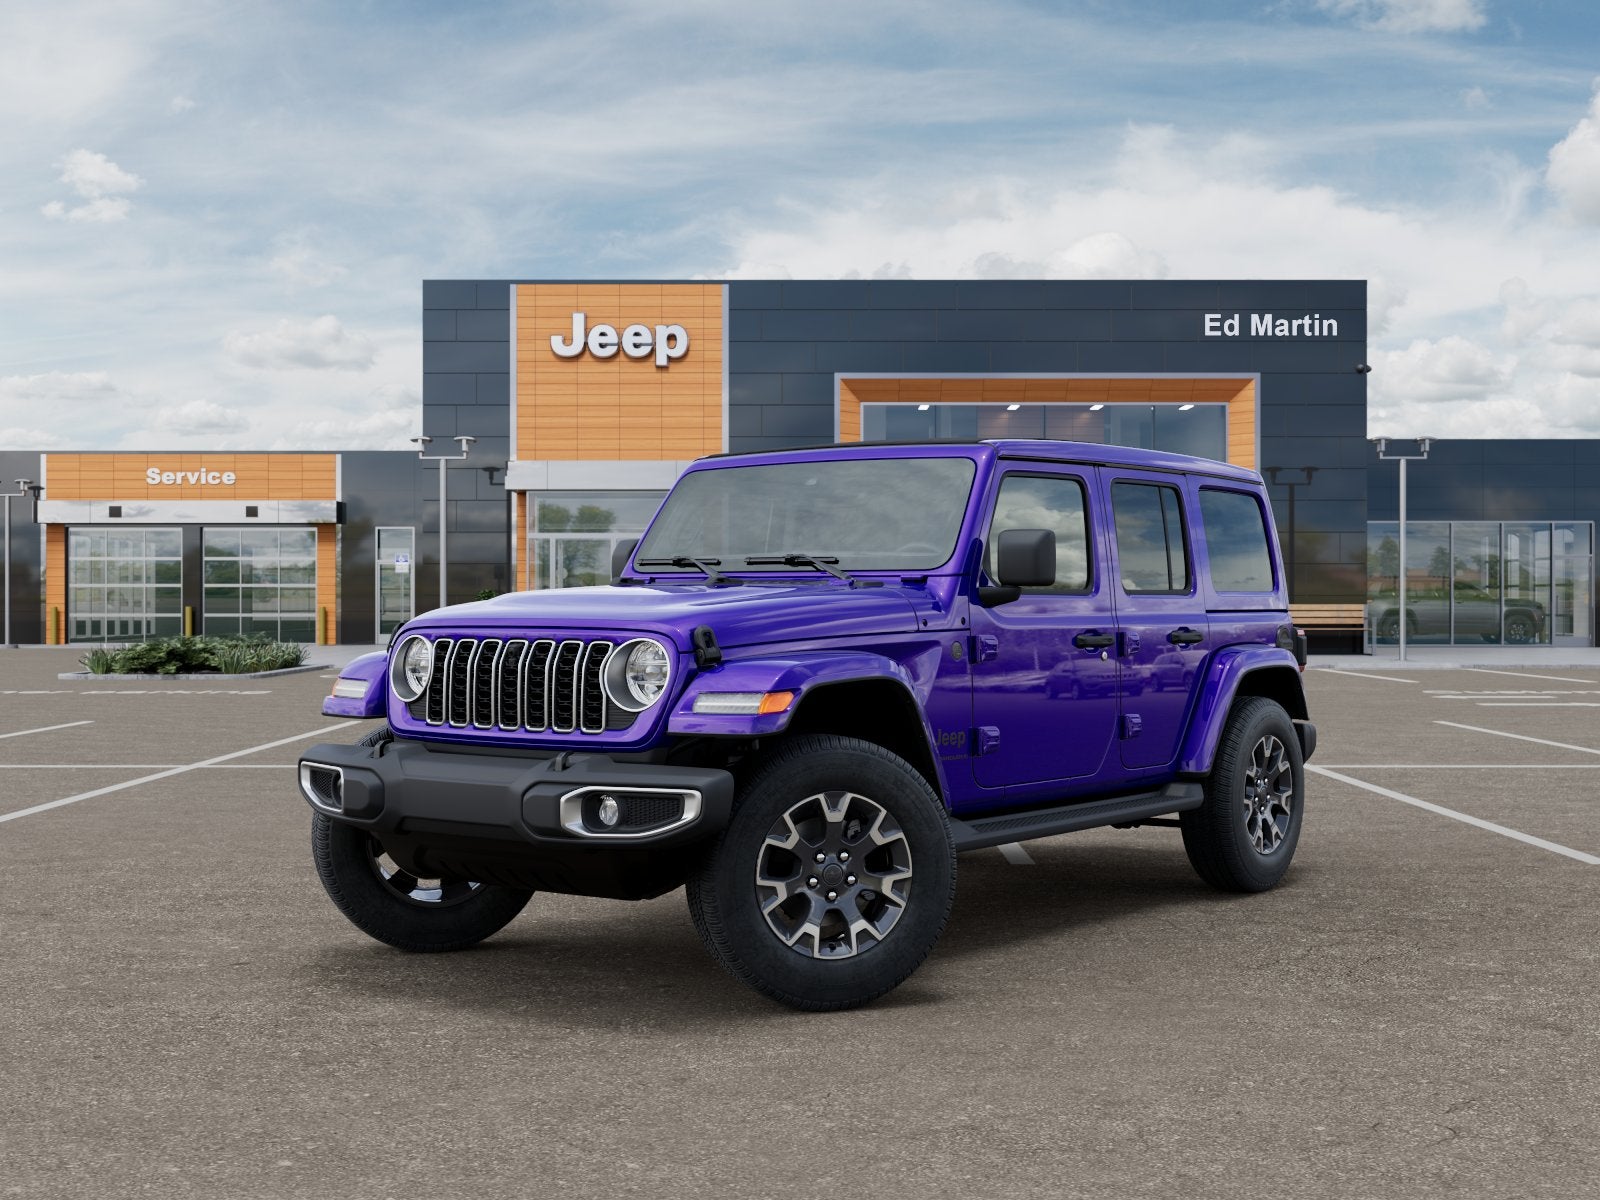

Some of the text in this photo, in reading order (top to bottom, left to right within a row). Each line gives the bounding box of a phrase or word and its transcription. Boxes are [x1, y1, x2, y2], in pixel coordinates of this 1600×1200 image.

[1204, 313, 1338, 336] Ed Martin
[550, 312, 688, 367] Jeep
[146, 467, 236, 485] Service
[936, 729, 966, 748] Jeep
